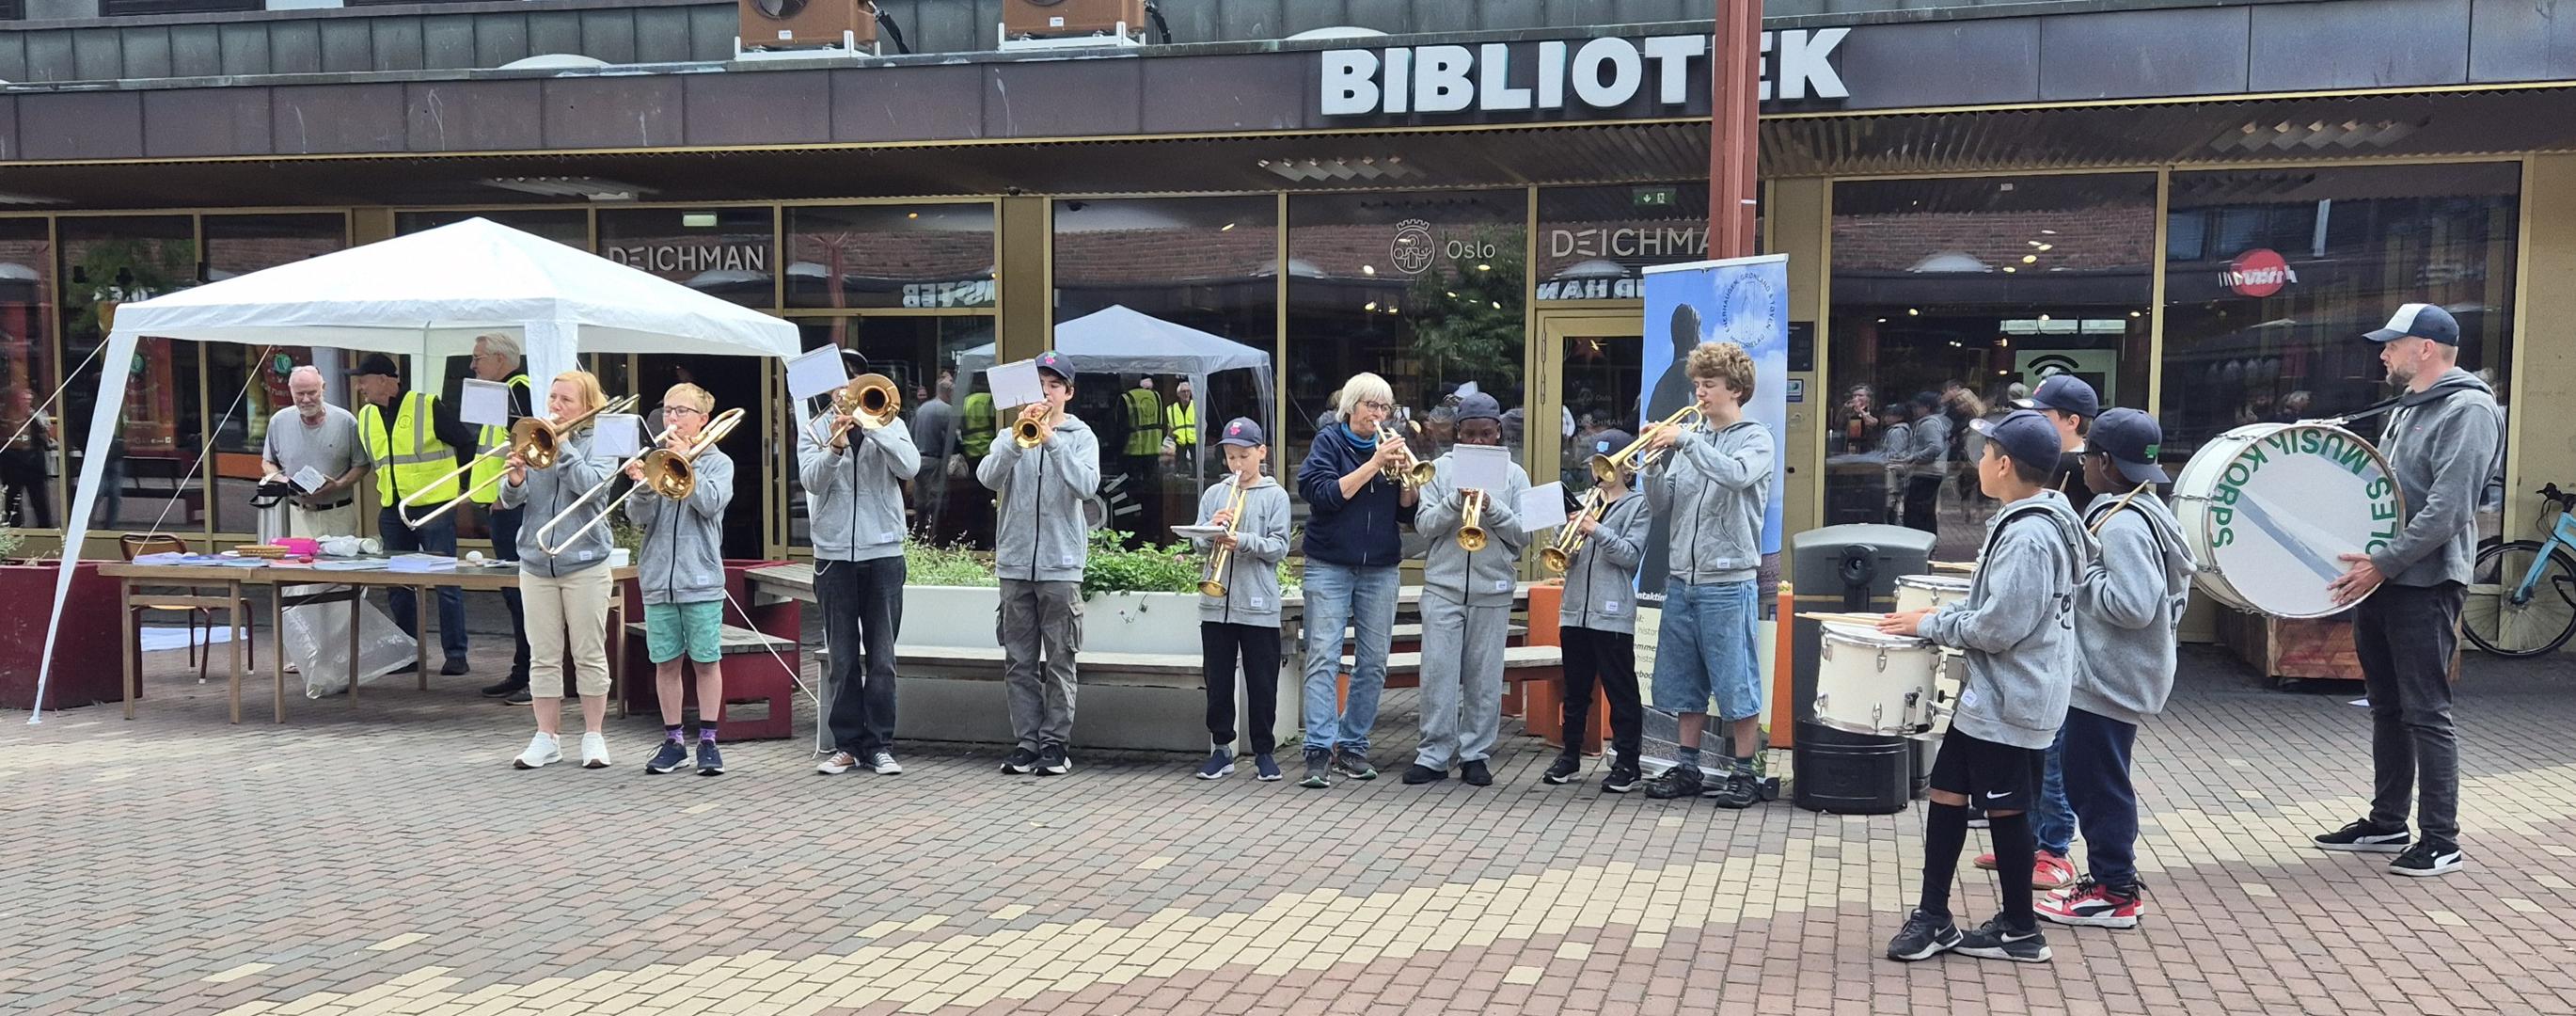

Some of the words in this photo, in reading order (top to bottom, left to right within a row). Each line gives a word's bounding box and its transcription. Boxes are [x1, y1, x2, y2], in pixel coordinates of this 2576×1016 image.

[1446, 240, 1496, 259] Oslo
[1552, 228, 1710, 258] DEICHMA
[608, 246, 765, 271] DEICHMAN
